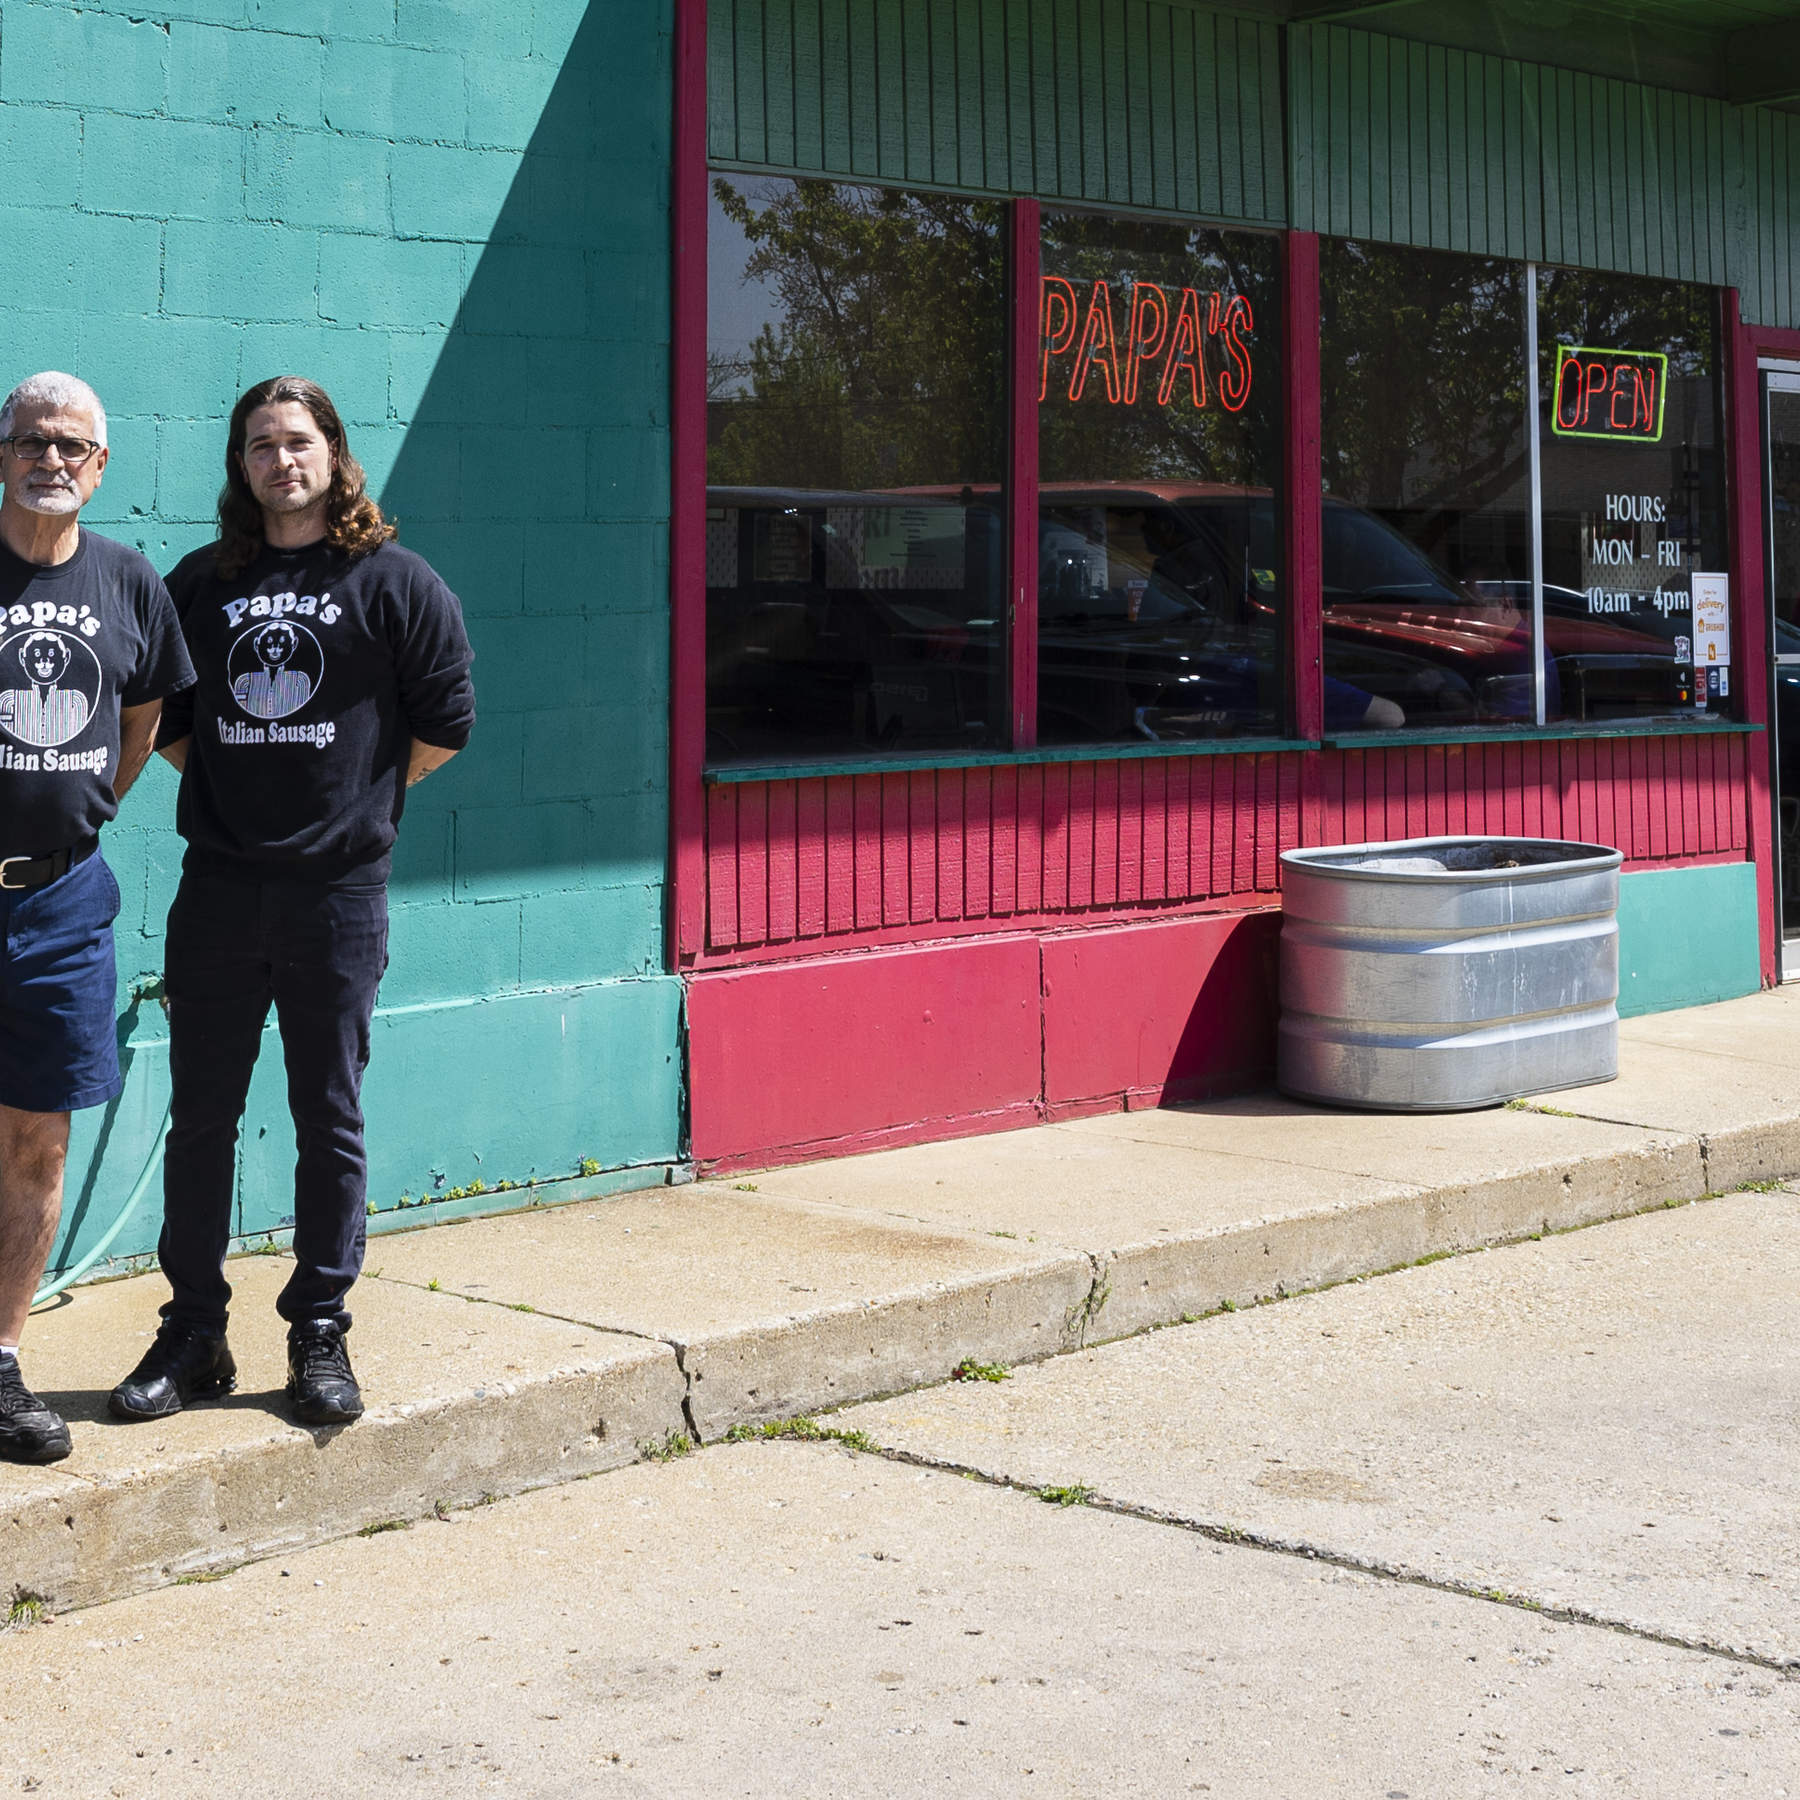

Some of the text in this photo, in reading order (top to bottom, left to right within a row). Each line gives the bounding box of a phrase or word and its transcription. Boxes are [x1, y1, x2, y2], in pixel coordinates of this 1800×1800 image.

[1038, 276, 1253, 412] PAPA'S
[1557, 358, 1655, 432] OPEN
[1606, 494, 1667, 522] HOURS:
[1592, 539, 1634, 566] MON
[1657, 541, 1681, 566] FRI
[221, 592, 342, 628] Papa's
[1587, 586, 1631, 614] 10am
[1653, 585, 1690, 618] 4pm
[217, 716, 336, 749] Italian Sausage
[43, 746, 107, 775] Sausage
